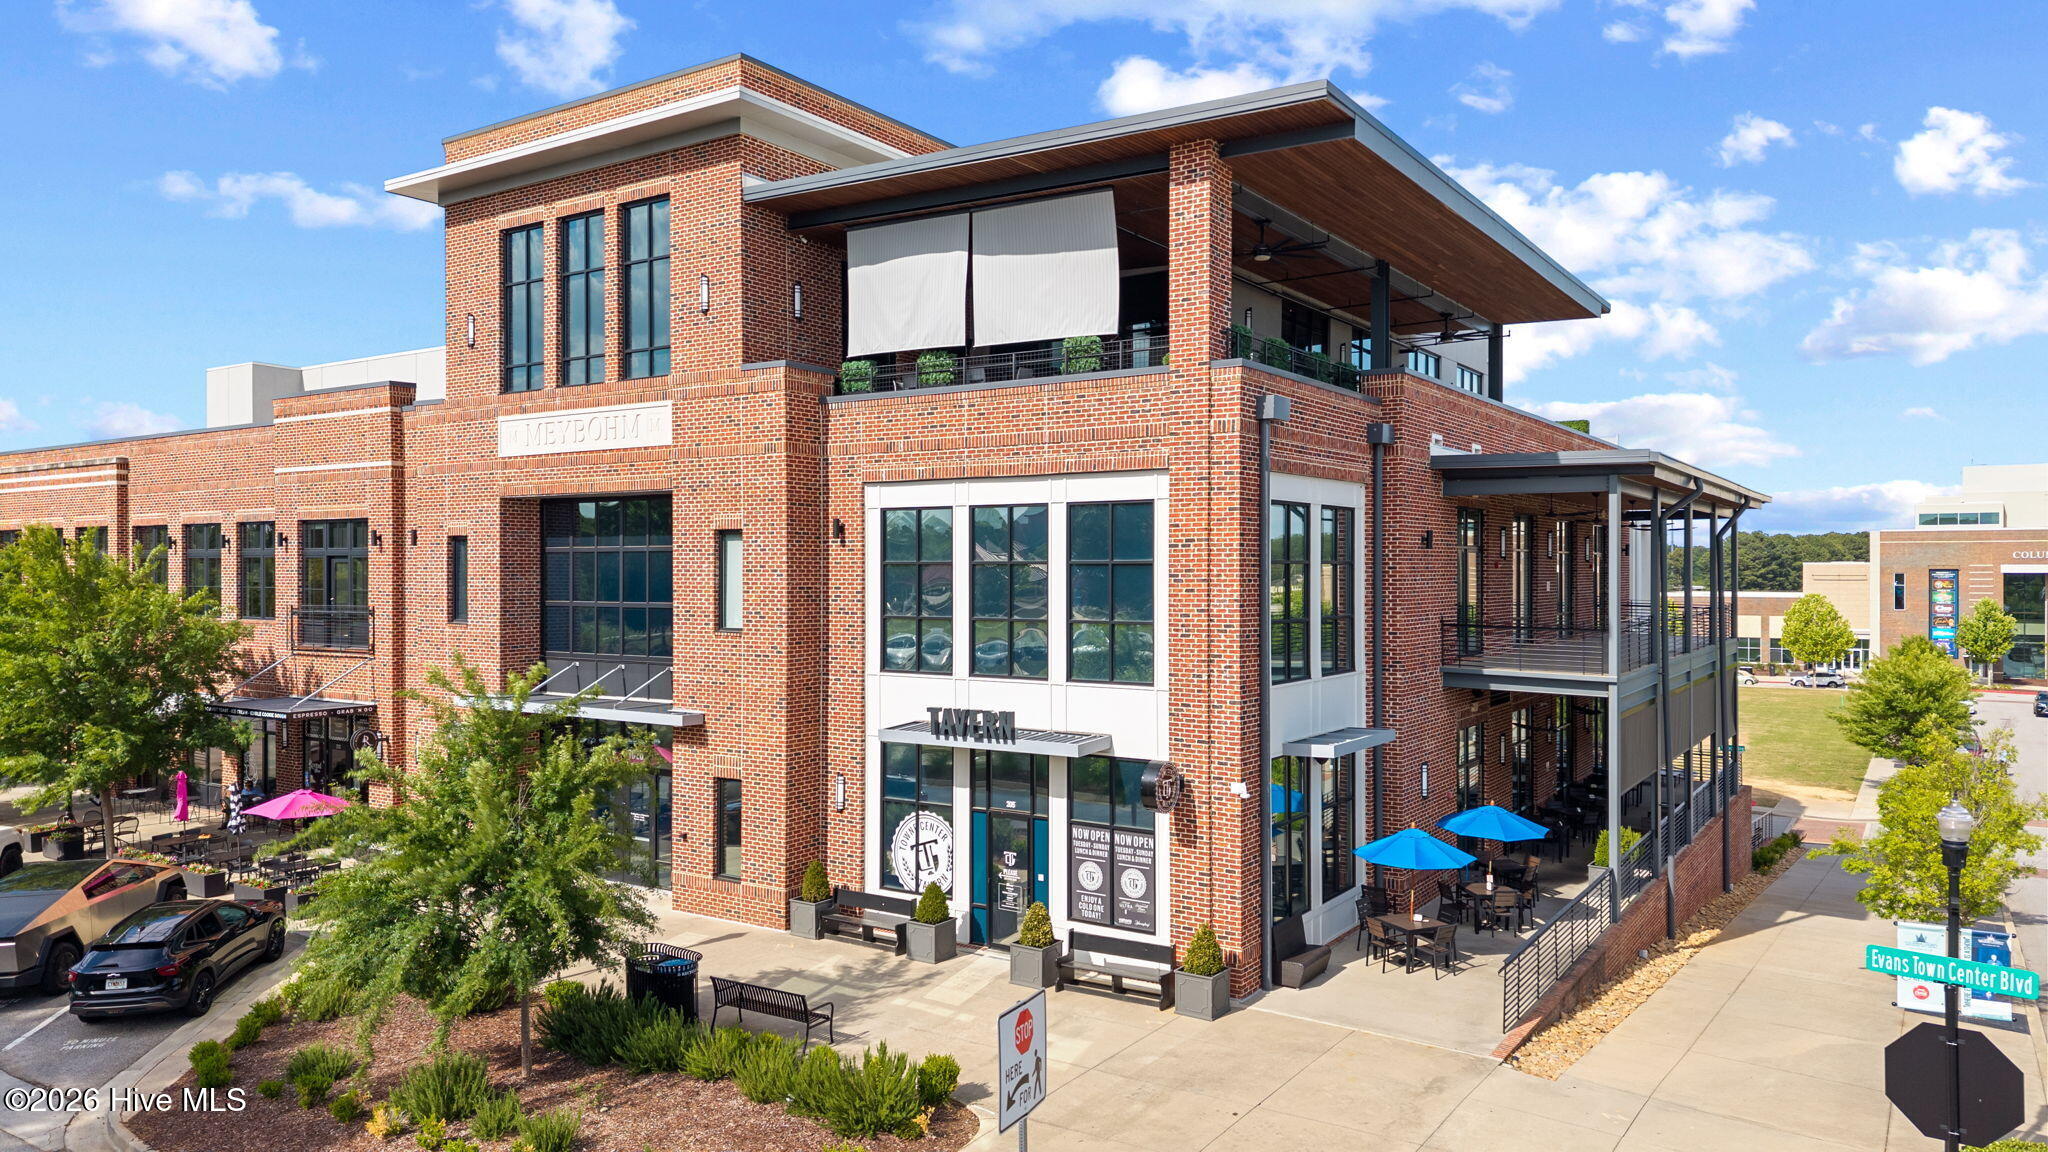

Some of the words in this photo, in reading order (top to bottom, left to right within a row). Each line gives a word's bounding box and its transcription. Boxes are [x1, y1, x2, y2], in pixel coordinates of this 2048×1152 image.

[525, 413, 641, 447] MEYBOHM
[2012, 551, 2048, 559] COLU
[292, 710, 328, 719] ESPRESSO
[927, 707, 1016, 741] TAVERN
[919, 821, 948, 842] CENTER
[1072, 827, 1090, 840] NOW
[1090, 830, 1111, 843] OPEN
[1114, 833, 1132, 846] NOW
[1133, 836, 1154, 850] OPEN
[1116, 854, 1131, 862] LUNCH
[1080, 894, 1098, 904] ENJOY
[1093, 904, 1104, 912] ONE
[1871, 949, 1909, 973] Evans
[1912, 955, 1945, 980] Town
[1948, 962, 1997, 988] Center
[2000, 970, 2033, 995] Blvd
[1016, 1019, 1032, 1045] STOP
[1005, 1060, 1022, 1084] HERE
[1019, 1086, 1032, 1107] FOR
